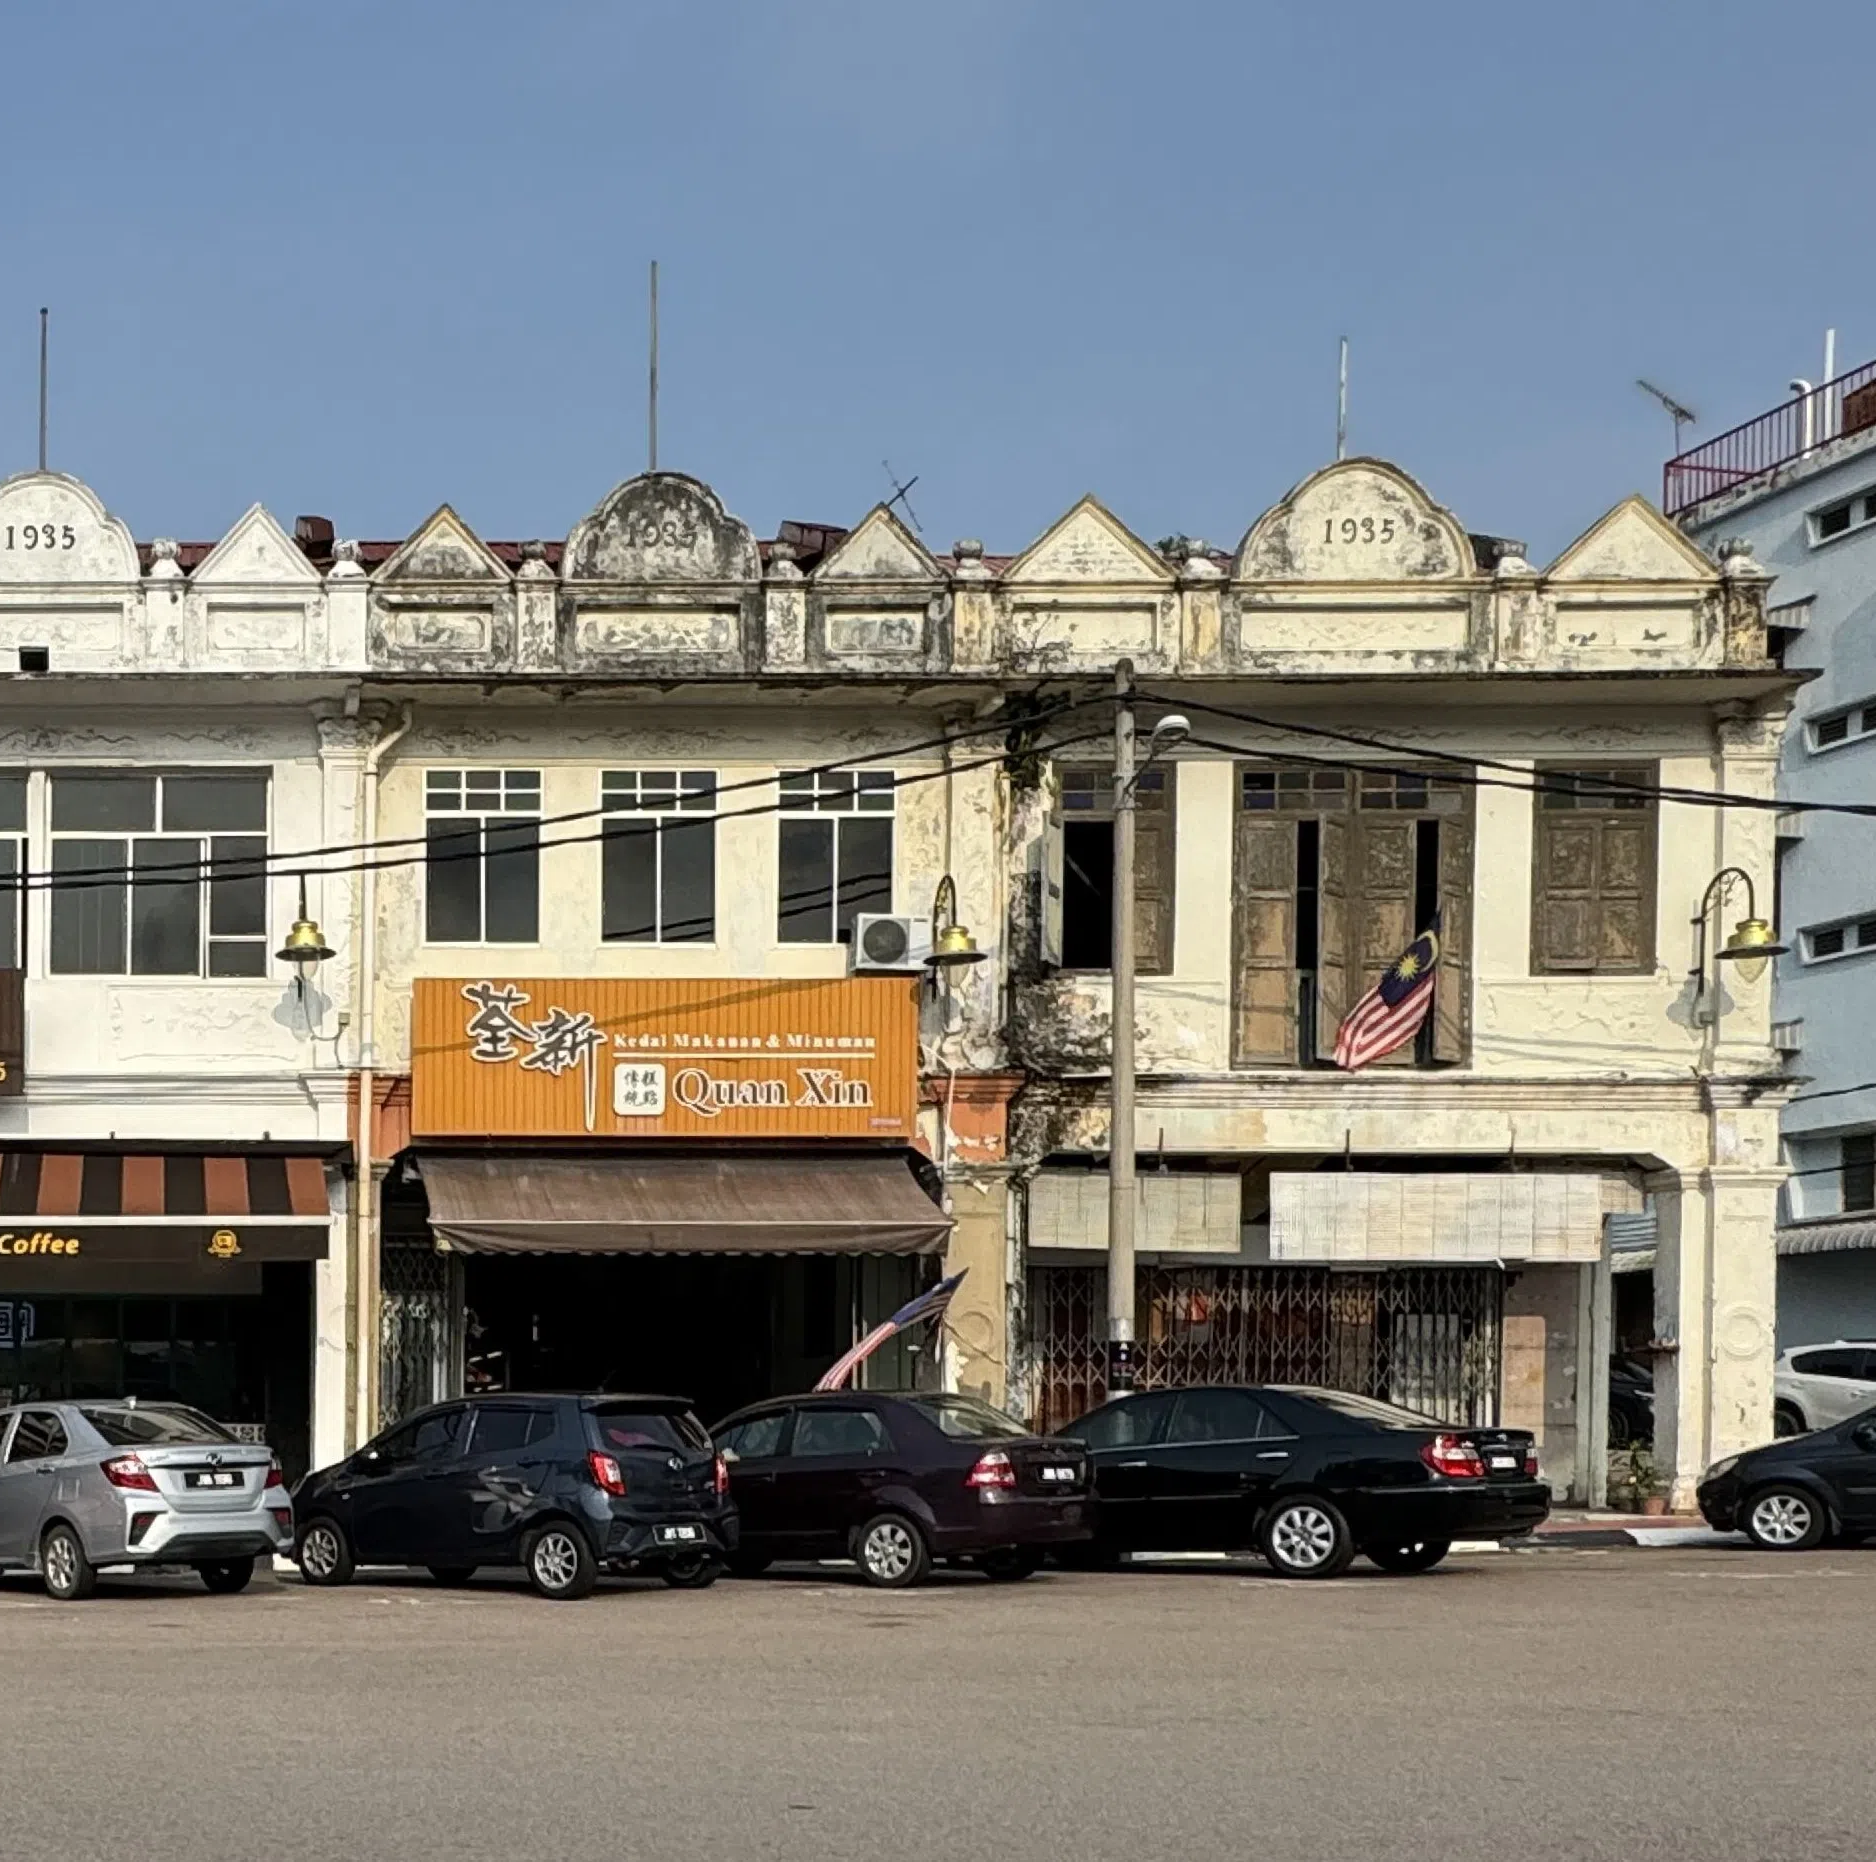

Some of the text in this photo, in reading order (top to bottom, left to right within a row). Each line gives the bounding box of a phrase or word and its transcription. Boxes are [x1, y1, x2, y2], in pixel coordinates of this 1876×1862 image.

[5, 523, 76, 550] 1935
[1323, 517, 1395, 544] 1935
[613, 1033, 876, 1048] Kedai Makanan & Minuman
[672, 1067, 874, 1117] Quan Xin
